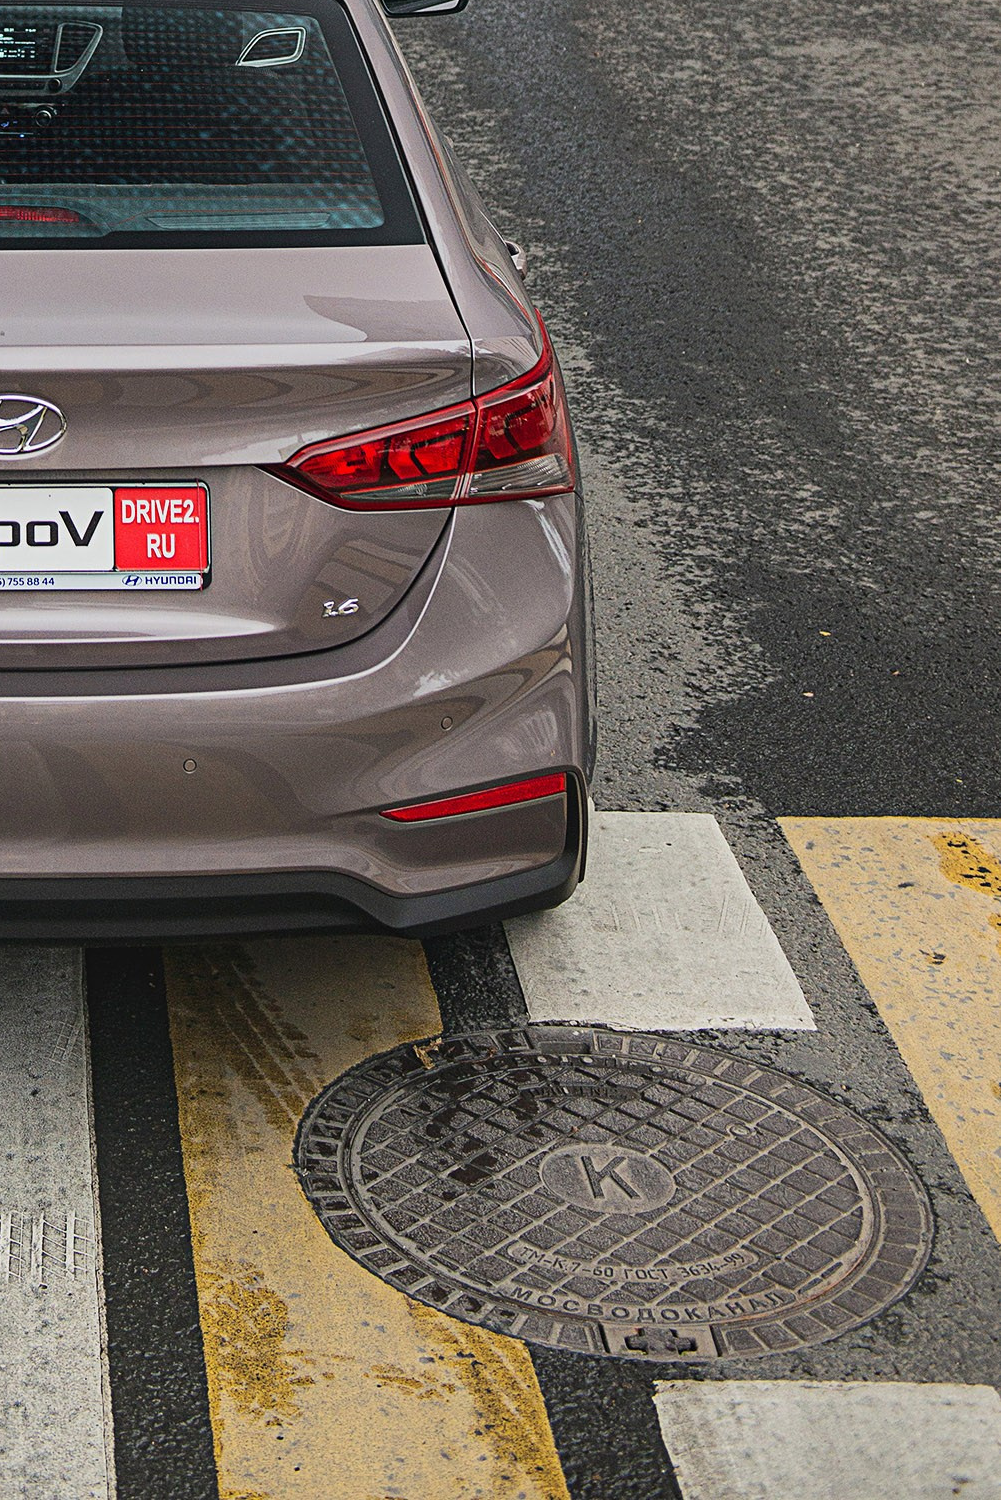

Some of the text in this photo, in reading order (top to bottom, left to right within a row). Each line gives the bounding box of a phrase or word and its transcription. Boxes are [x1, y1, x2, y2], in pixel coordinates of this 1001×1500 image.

[120, 498, 200, 524] DRIVE2.
[146, 533, 176, 559] RU
[7, 577, 24, 587] 755
[26, 577, 40, 587] 88
[41, 577, 55, 587] 44
[144, 575, 197, 586] HYUNDAI
[322, 598, 359, 618] 1.6
[580, 1155, 642, 1200] К
[623, 1267, 669, 1281] ГОСТ
[678, 1251, 746, 1279] 3634-99
[509, 1285, 788, 1324] МОСВОДОКАНАЛ
